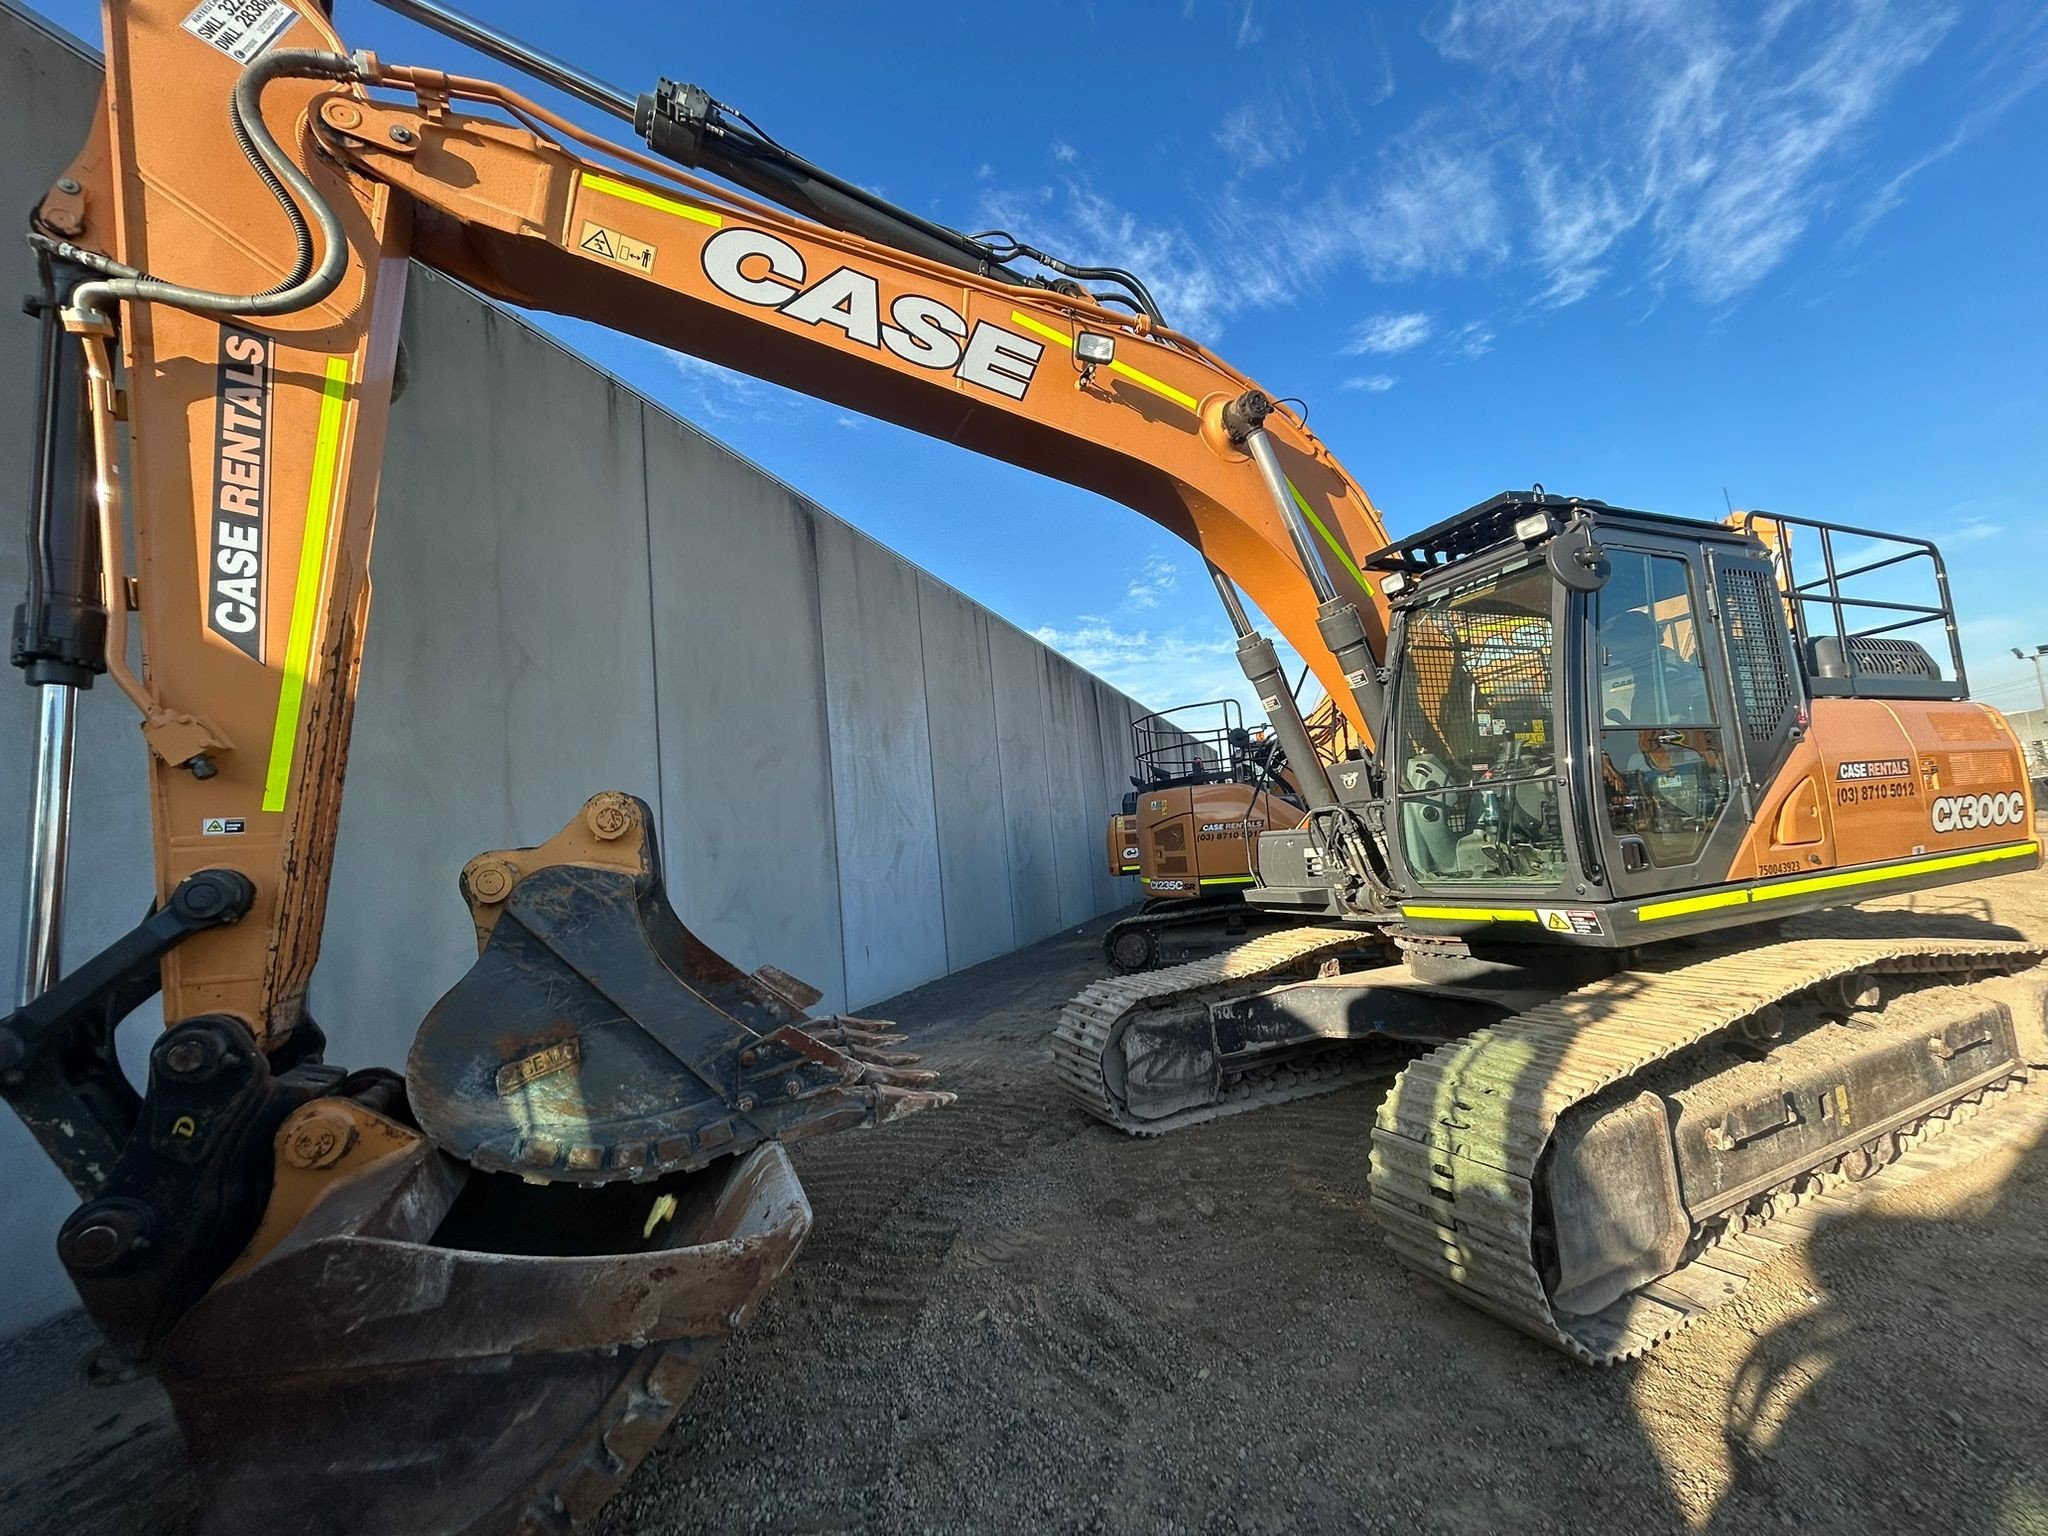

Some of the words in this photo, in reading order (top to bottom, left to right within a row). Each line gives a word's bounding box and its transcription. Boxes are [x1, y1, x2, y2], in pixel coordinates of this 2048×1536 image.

[197, 16, 226, 39] SWLL
[214, 27, 244, 51] DWLL
[701, 227, 1046, 401] CASE
[220, 335, 265, 517] RENTALS
[215, 521, 258, 633] CASE
[1840, 763, 1867, 778] CASE
[1867, 761, 1909, 776] RENTALS
[1837, 786, 1858, 806] (03)
[1861, 784, 1887, 800] 8710
[1890, 782, 1915, 797] 5012
[1932, 790, 2024, 833] CX300C
[1197, 834, 1214, 843] (03)
[1217, 832, 1239, 840] 8710
[1202, 823, 1224, 831] CASE
[1758, 861, 1800, 876] 750043923
